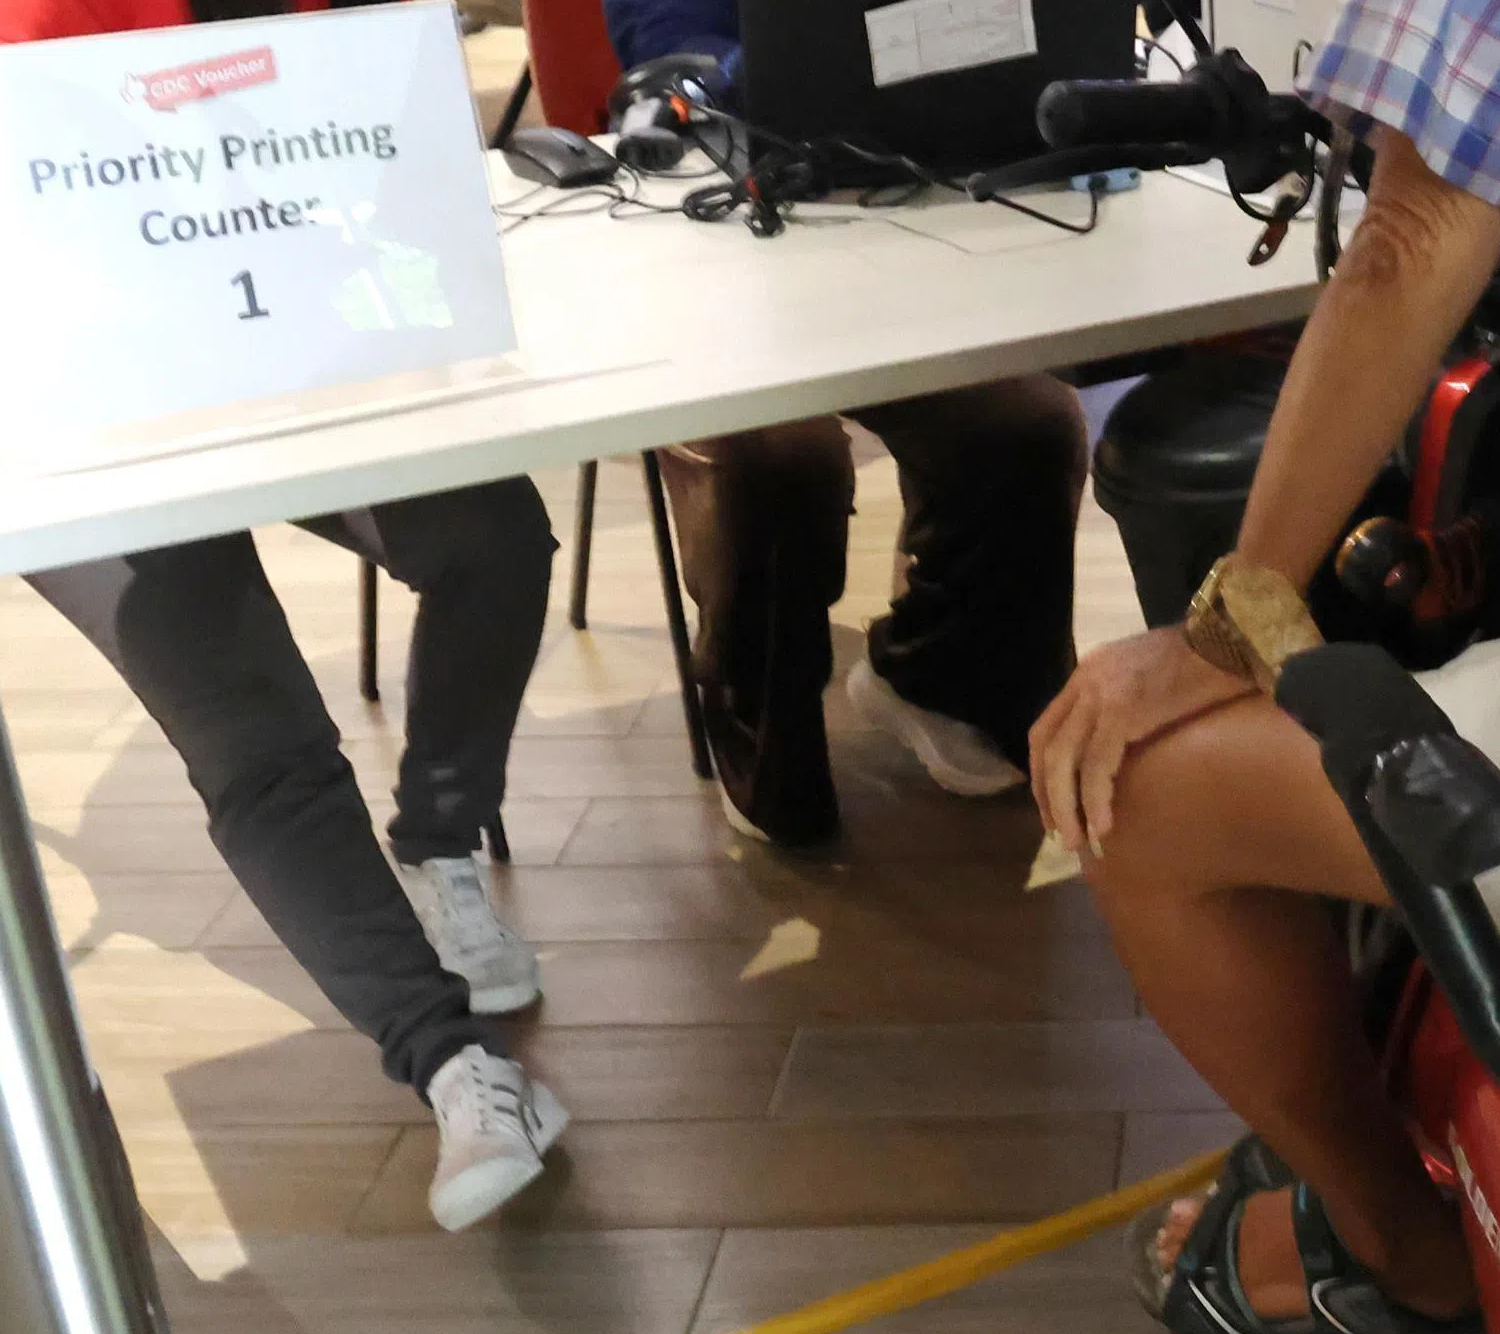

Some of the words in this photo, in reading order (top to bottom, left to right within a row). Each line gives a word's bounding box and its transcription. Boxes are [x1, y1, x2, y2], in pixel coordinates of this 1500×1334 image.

[193, 57, 266, 88] Voucher
[28, 142, 205, 195] Priority
[219, 120, 397, 171] Printing
[229, 268, 271, 321] 1
